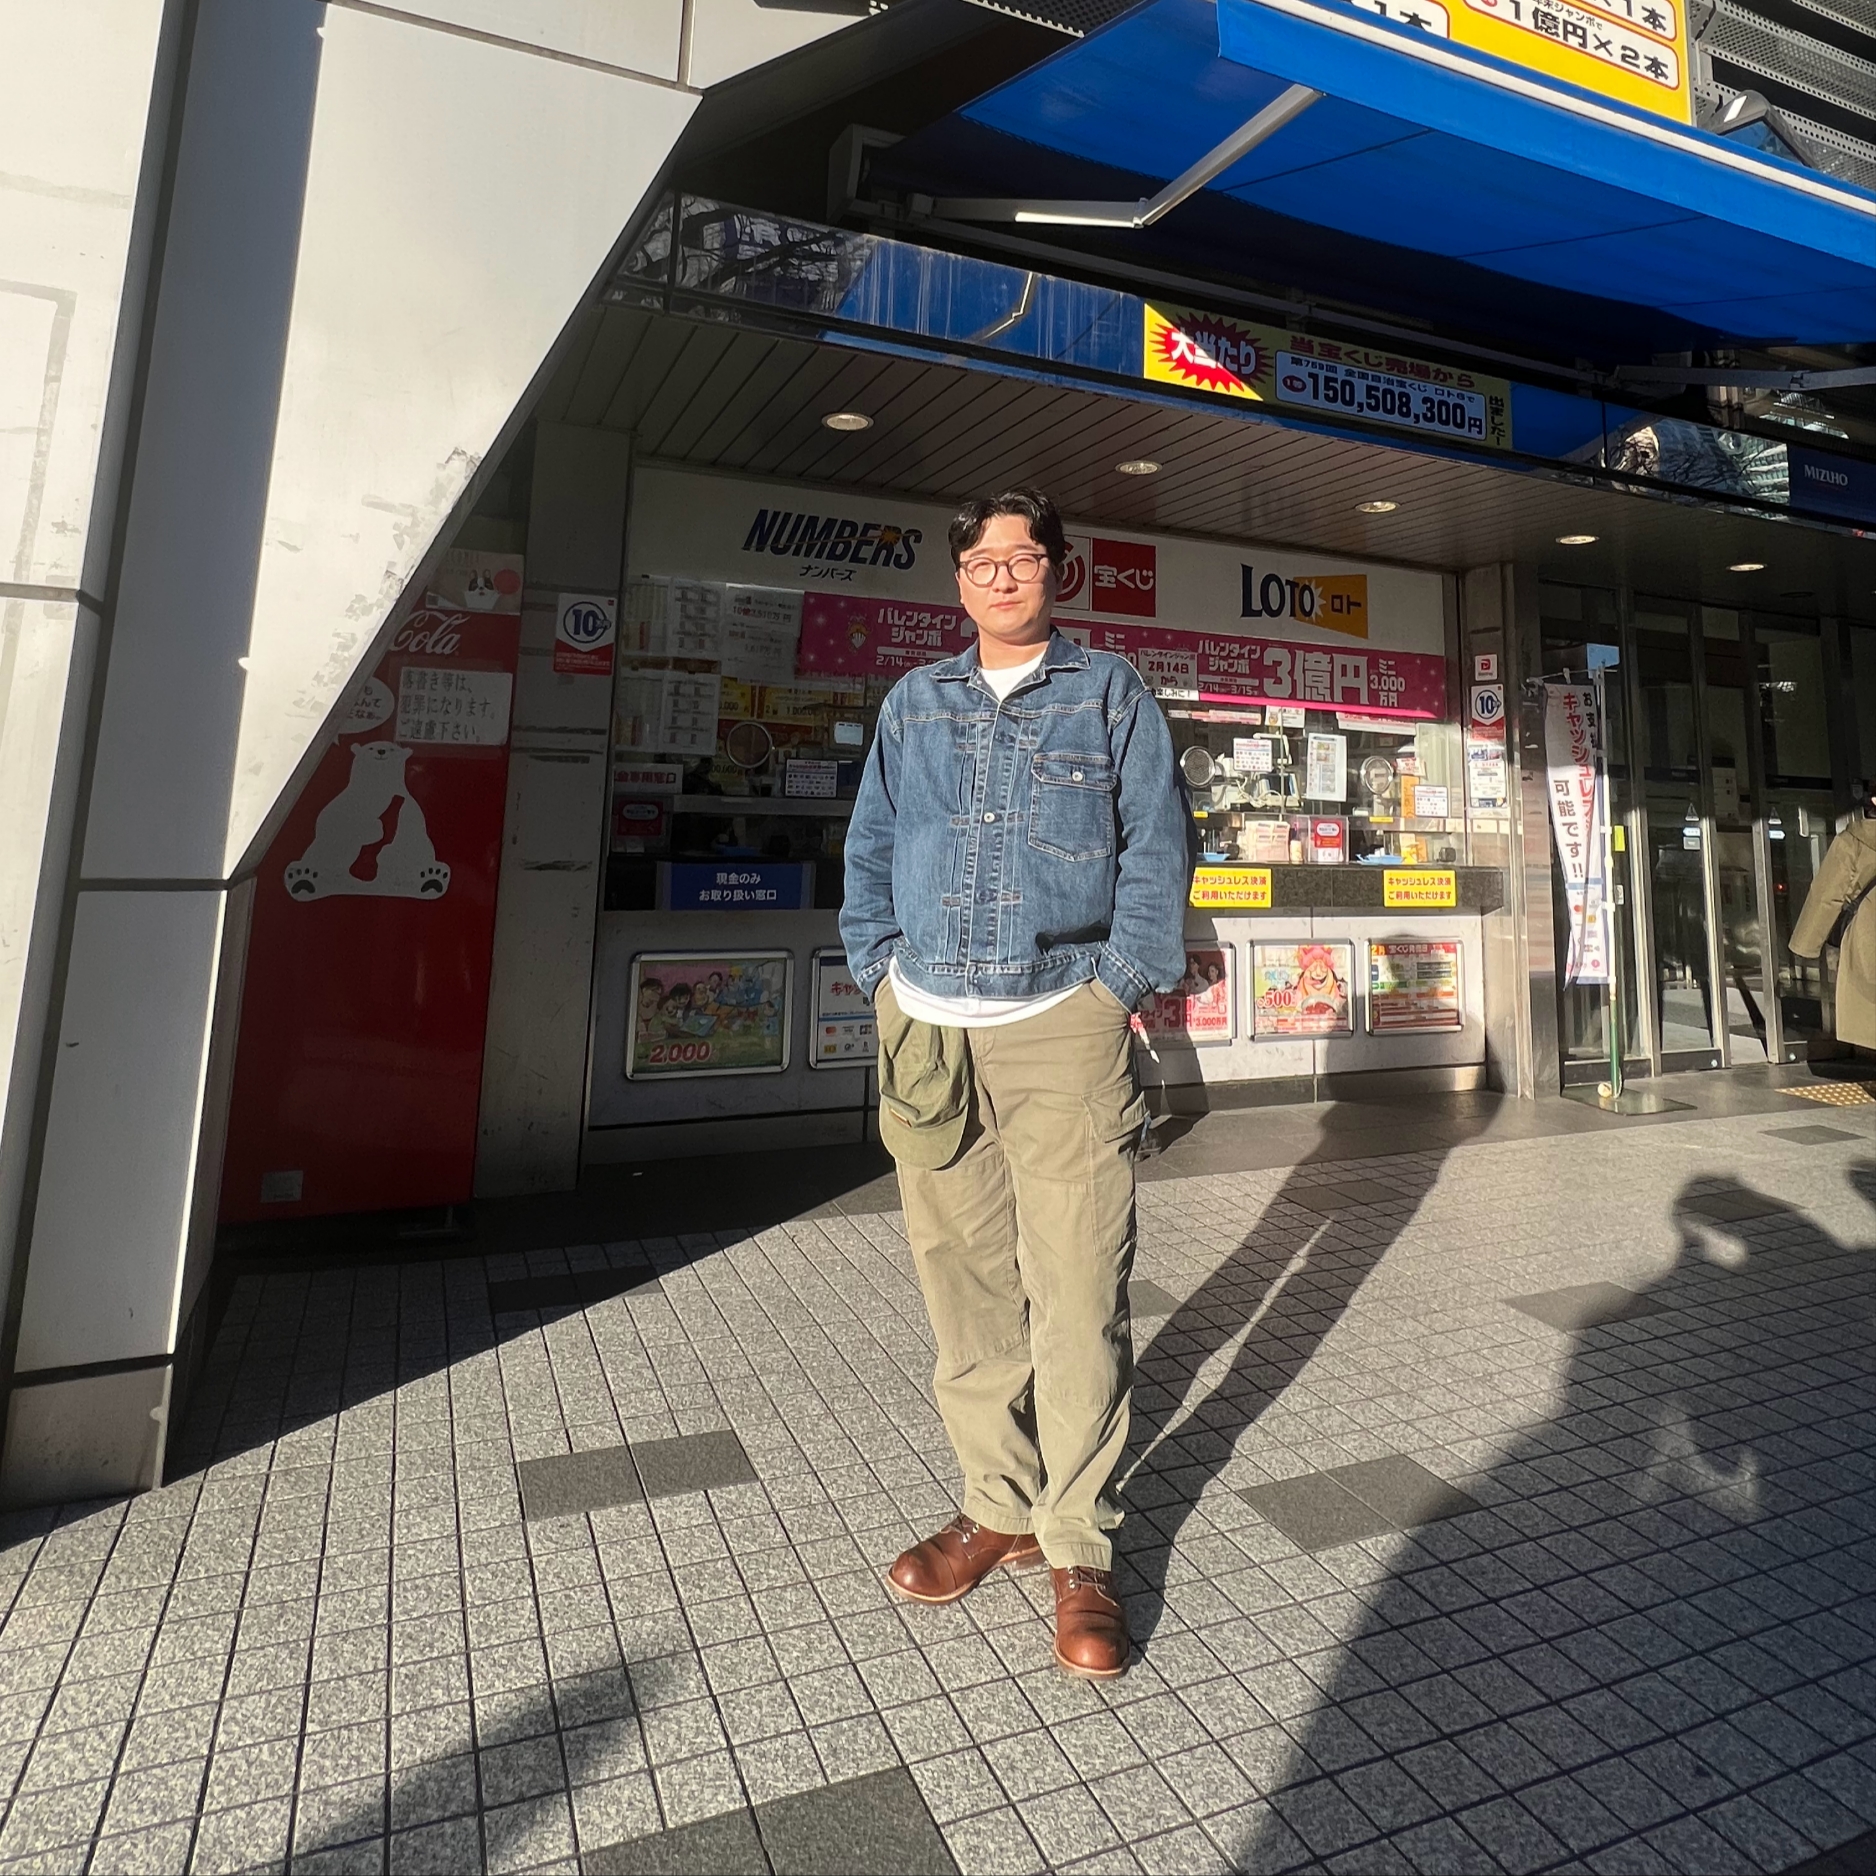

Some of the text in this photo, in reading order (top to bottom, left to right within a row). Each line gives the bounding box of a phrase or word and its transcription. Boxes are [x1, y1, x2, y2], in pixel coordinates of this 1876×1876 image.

[1170, 326, 1257, 376] 大当たり
[1289, 335, 1476, 388] 当宝くじ売場から
[1307, 371, 1484, 436] 150,508,300円
[1803, 464, 1850, 488] MIZUHO
[741, 508, 923, 571] NUMBERS
[799, 564, 857, 582] ナンバーズ
[1093, 564, 1154, 592] 宝くじ
[1240, 563, 1362, 618] LOTO ロト
[877, 606, 958, 631] バレンタイン
[891, 627, 943, 647] ジャンボ
[1105, 631, 1127, 651] ミニ
[1197, 639, 1261, 660] バレンタイン
[1147, 660, 1189, 675] 2月14日
[1208, 656, 1250, 675] ジャンボ
[1263, 646, 1370, 705] 3億円
[1378, 658, 1396, 676] ミニ
[1160, 675, 1179, 687] から
[1378, 691, 1398, 708] 万円
[1562, 693, 1595, 832] キャッシュレス
[613, 770, 677, 785] 金専用窓口
[1553, 779, 1585, 879] 可能です!!
[716, 872, 762, 886] 現金のみ
[1192, 875, 1267, 887] キャッシュレス決済
[1387, 875, 1452, 887] キャッシュレス決済
[698, 889, 778, 902] お取り扱い窓口
[1192, 890, 1268, 901] ご利用いただけます
[1388, 890, 1452, 901] ご利用いただけます
[1263, 990, 1292, 1007] 500
[649, 1040, 711, 1064] 2,000
